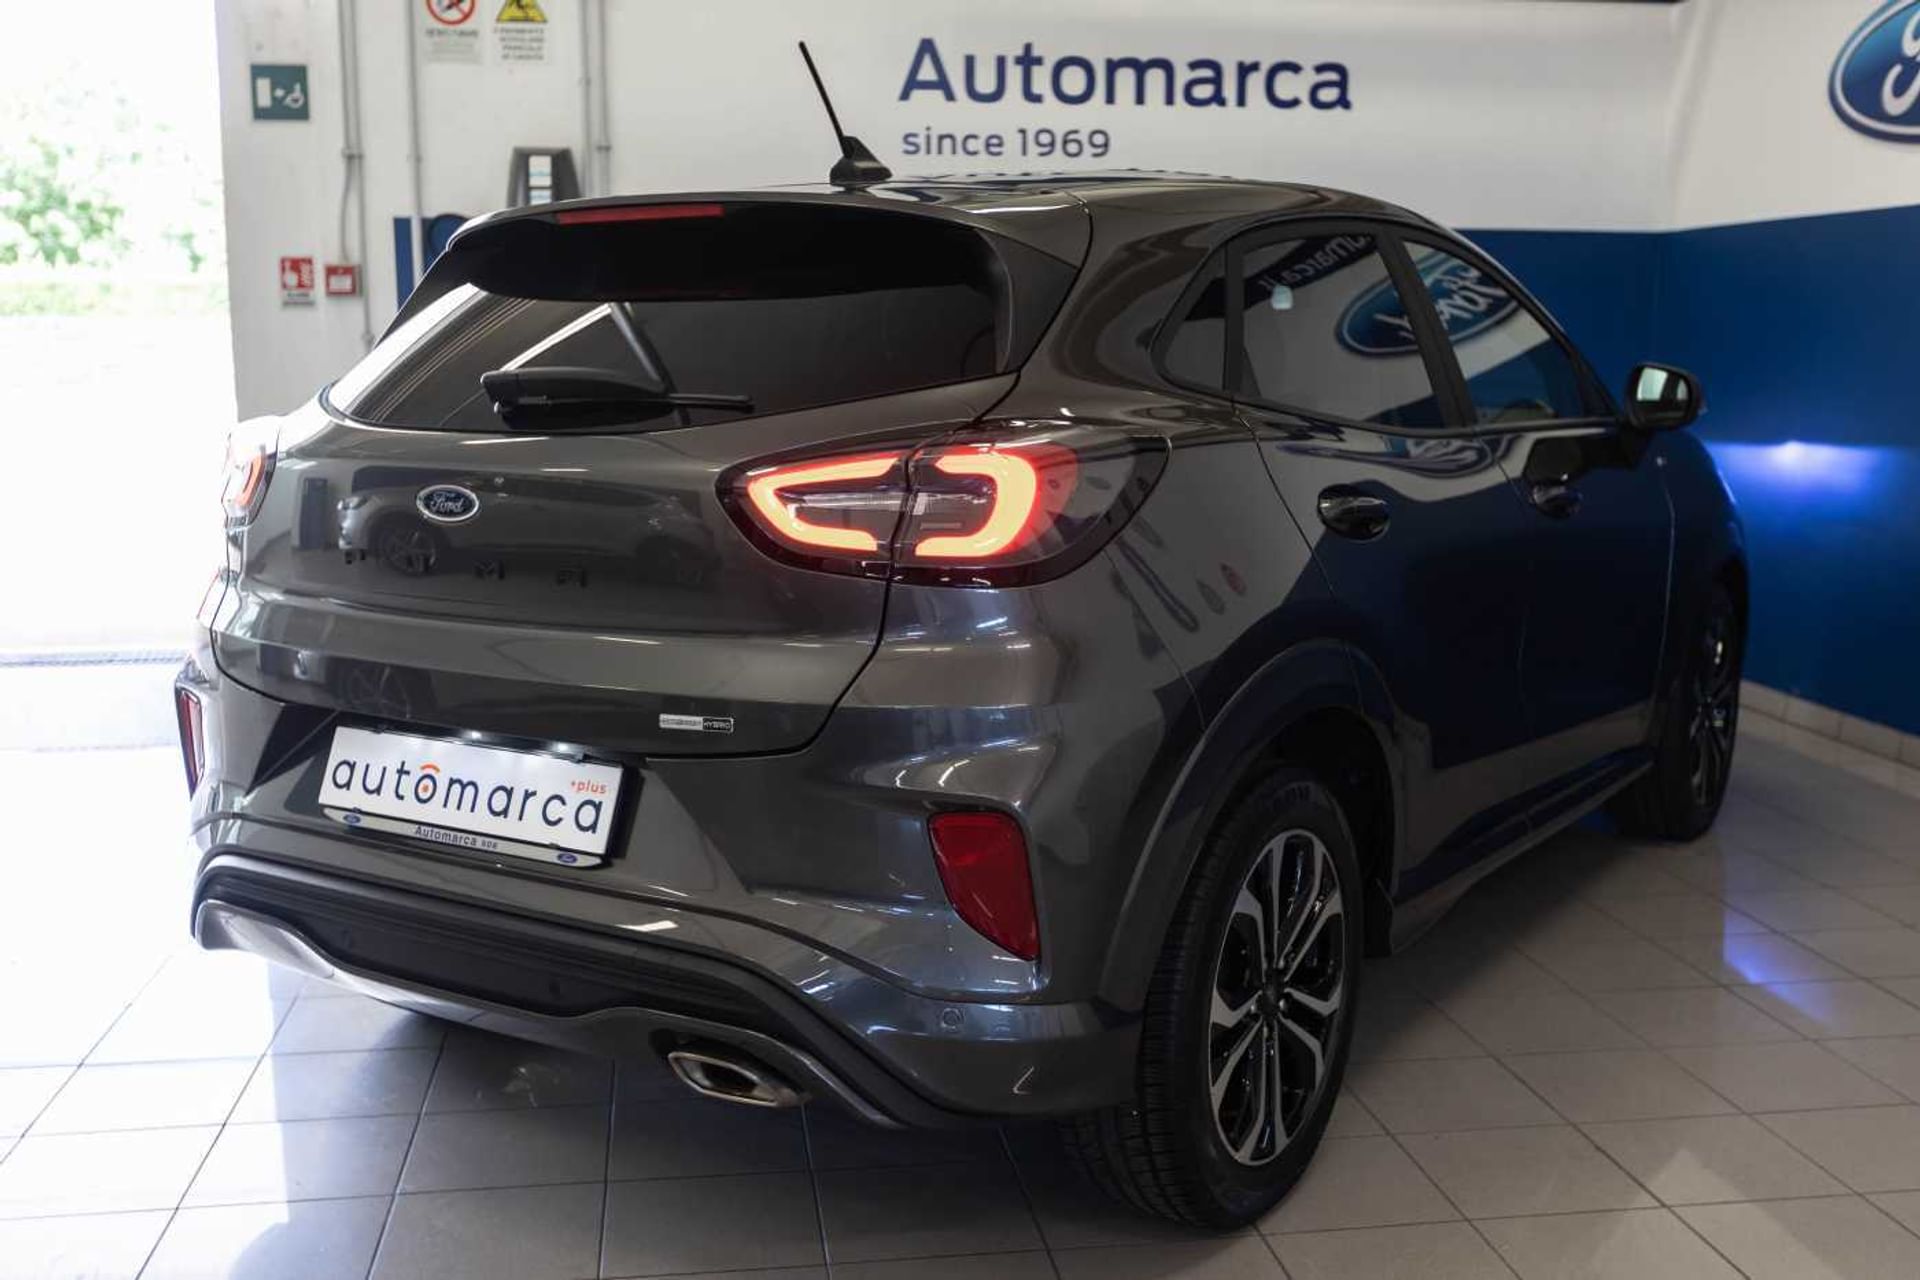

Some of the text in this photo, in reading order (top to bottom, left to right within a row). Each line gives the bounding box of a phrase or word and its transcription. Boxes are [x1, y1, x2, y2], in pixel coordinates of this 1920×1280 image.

[899, 38, 1352, 110] Automarca
[902, 127, 1111, 158] since 1969
[430, 491, 464, 513] Ford
[415, 825, 477, 847] Automarca
